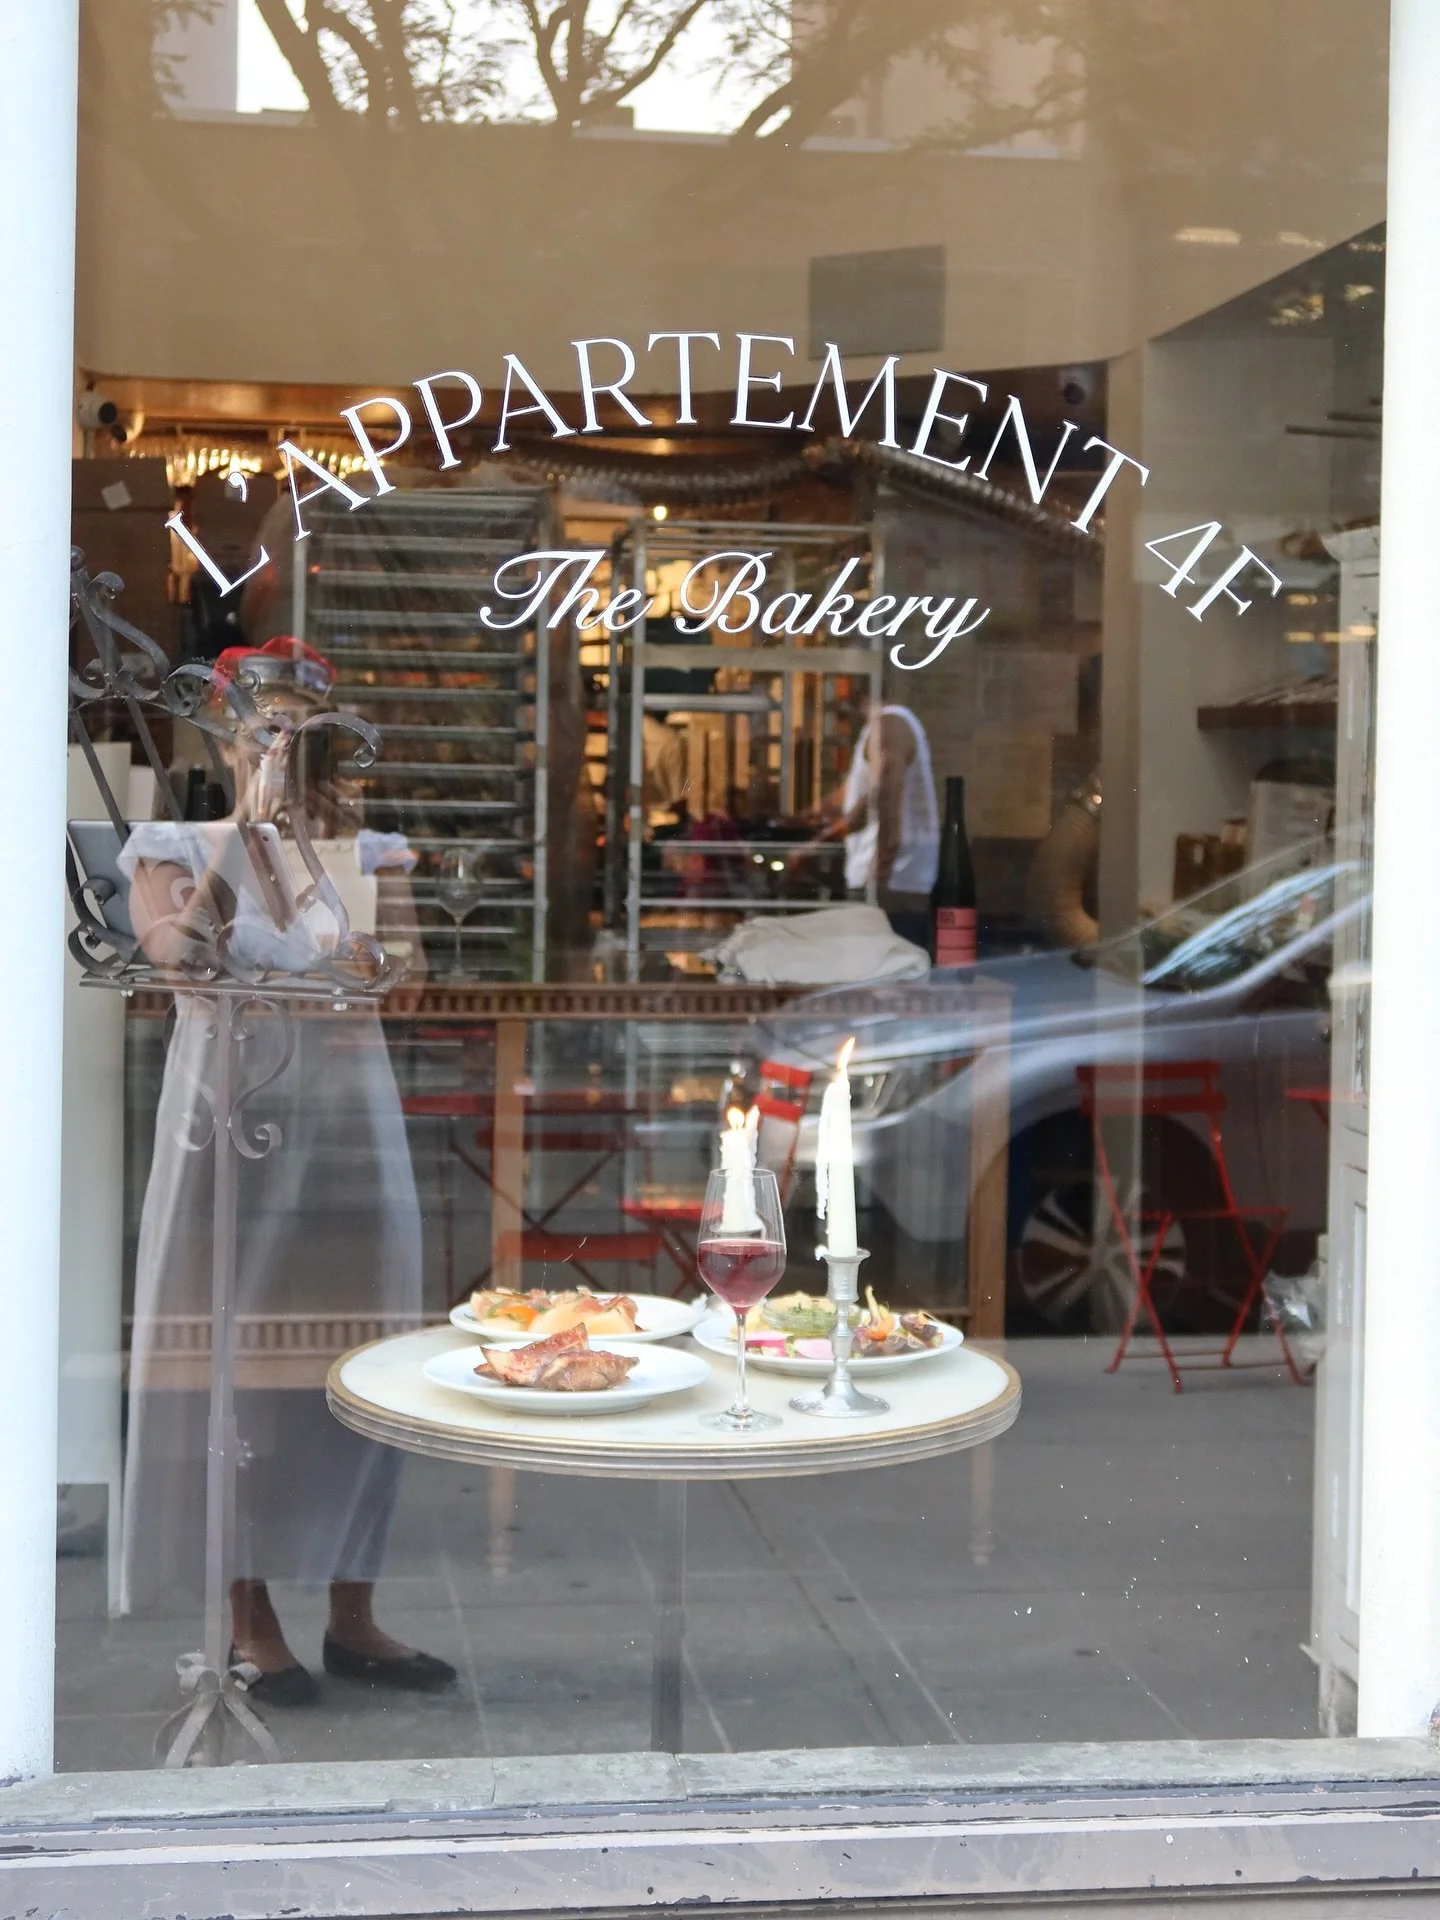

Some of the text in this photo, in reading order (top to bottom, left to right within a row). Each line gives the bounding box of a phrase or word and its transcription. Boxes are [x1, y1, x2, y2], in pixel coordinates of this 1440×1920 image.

[164, 331, 1283, 622] L'APPARTEMENT 4F
[479, 549, 992, 671] The Bakery
